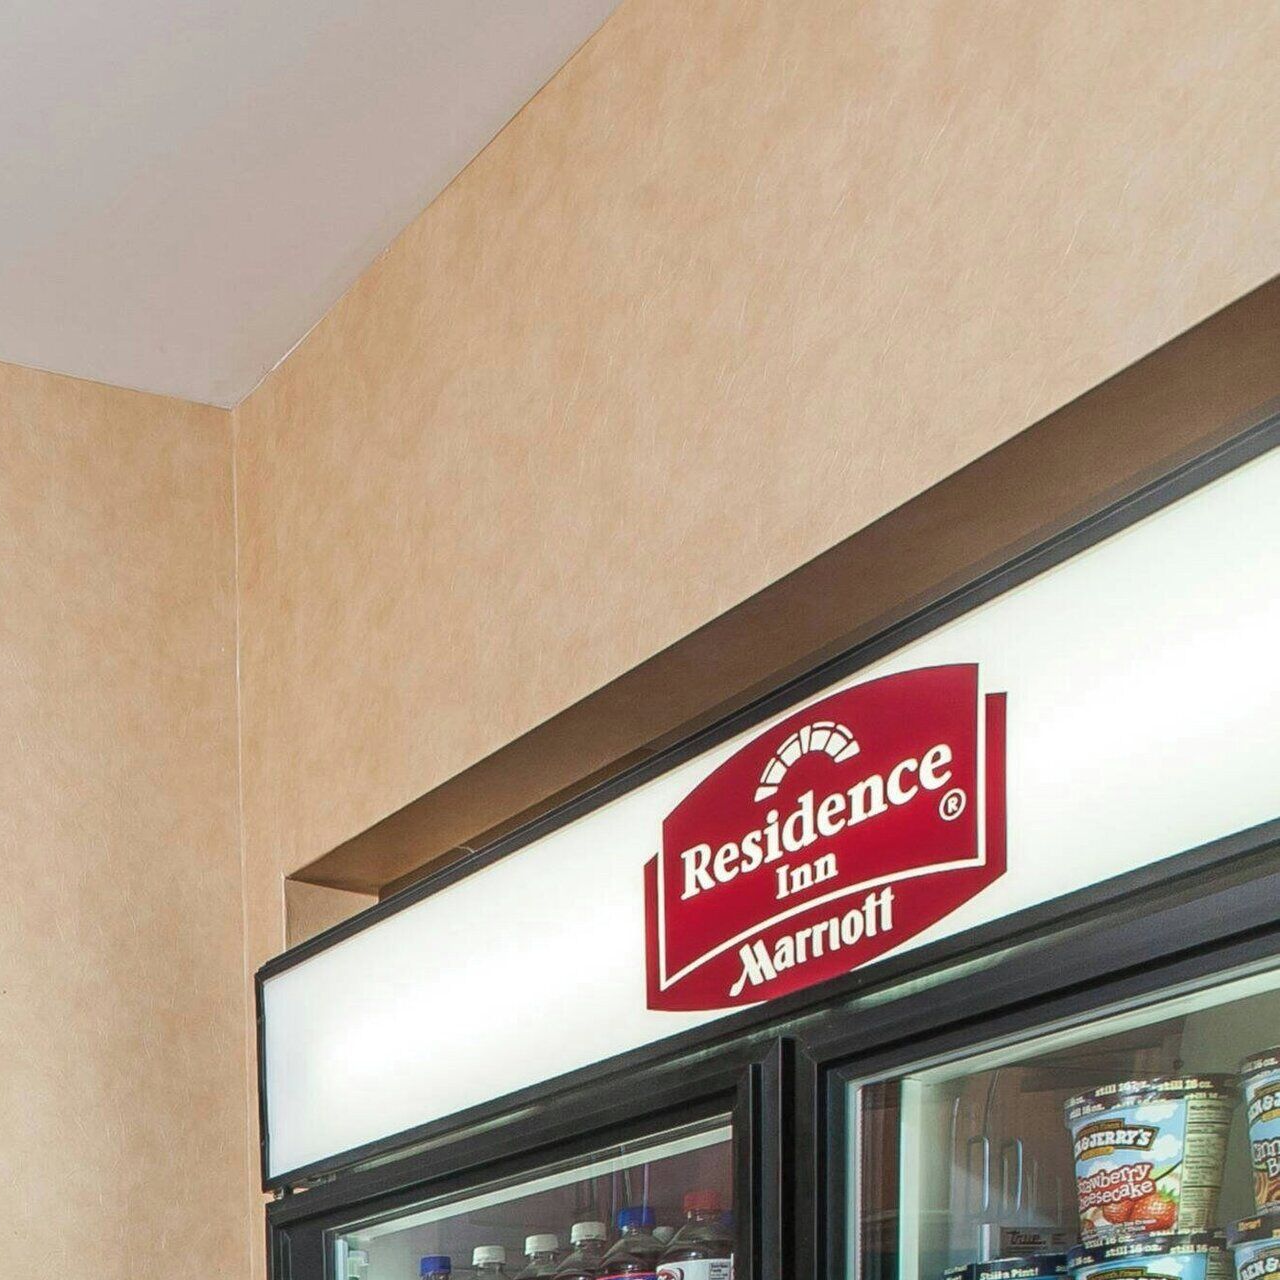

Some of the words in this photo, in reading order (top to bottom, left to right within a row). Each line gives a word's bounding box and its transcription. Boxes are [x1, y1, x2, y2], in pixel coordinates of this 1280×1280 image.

[680, 743, 953, 901] Residence
[776, 852, 838, 899] Inn
[729, 887, 894, 997] Marriott
